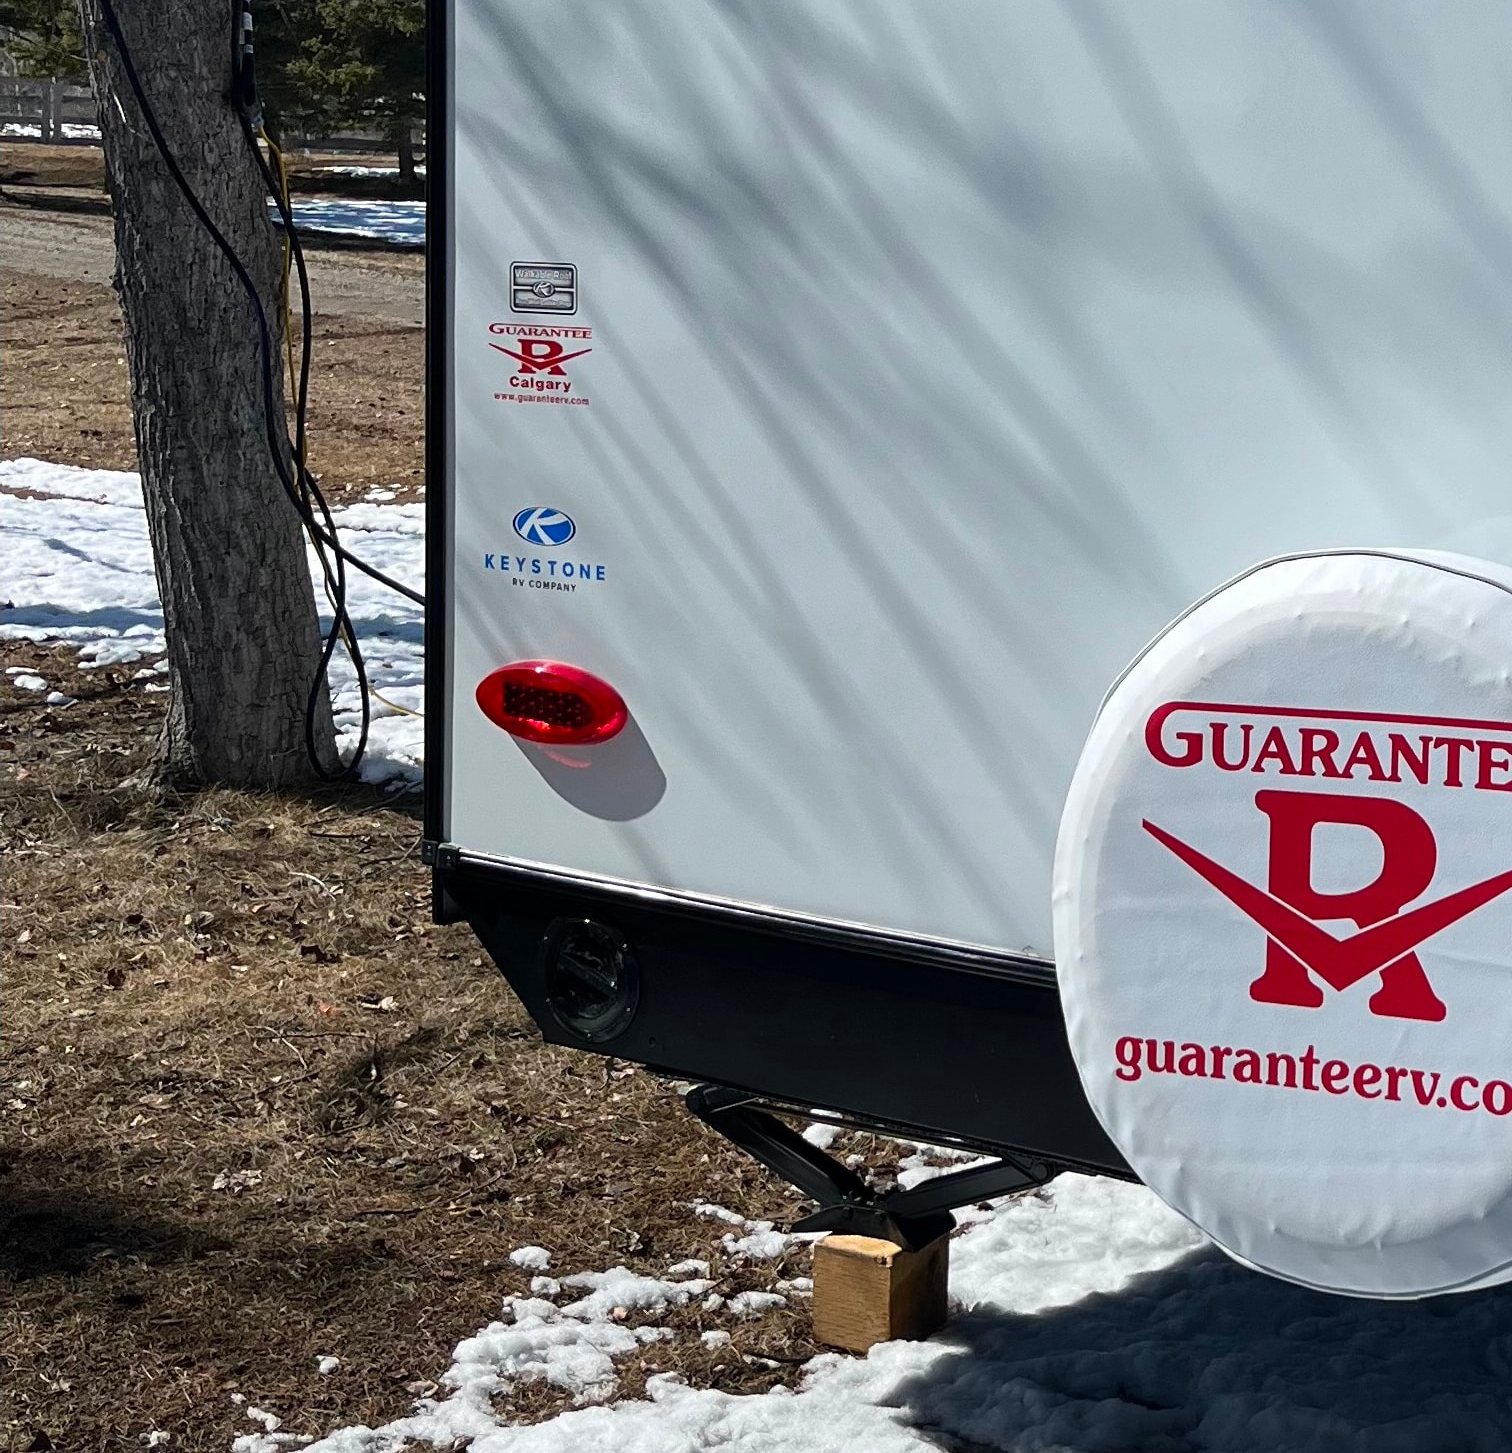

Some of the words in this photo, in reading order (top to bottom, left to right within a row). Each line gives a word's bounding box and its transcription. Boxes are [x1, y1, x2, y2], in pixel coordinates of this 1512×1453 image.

[488, 322, 593, 340] GUARANTEE
[509, 375, 572, 392] Calgary
[493, 392, 590, 406] www.guaranteerv.com
[484, 553, 606, 581] KEYSTONE
[512, 577, 525, 587] RV
[528, 579, 577, 592] COMPANY
